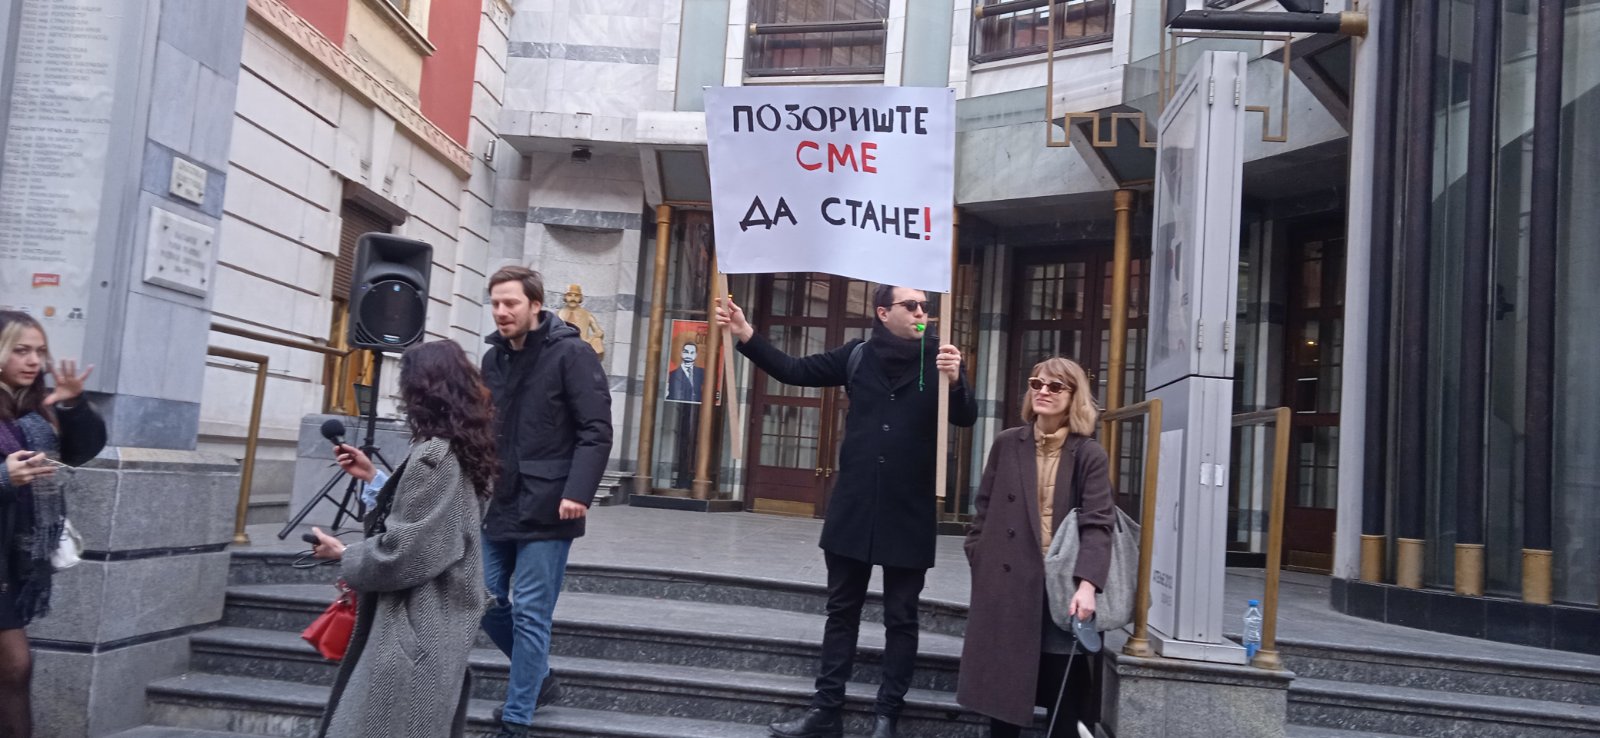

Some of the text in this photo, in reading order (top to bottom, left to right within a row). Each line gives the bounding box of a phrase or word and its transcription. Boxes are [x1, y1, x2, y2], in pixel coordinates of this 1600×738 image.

[732, 104, 929, 135] ПОЗОРИШТЕ
[796, 140, 878, 174] СМЕ
[739, 195, 932, 241] ДА СТАНЕ!
